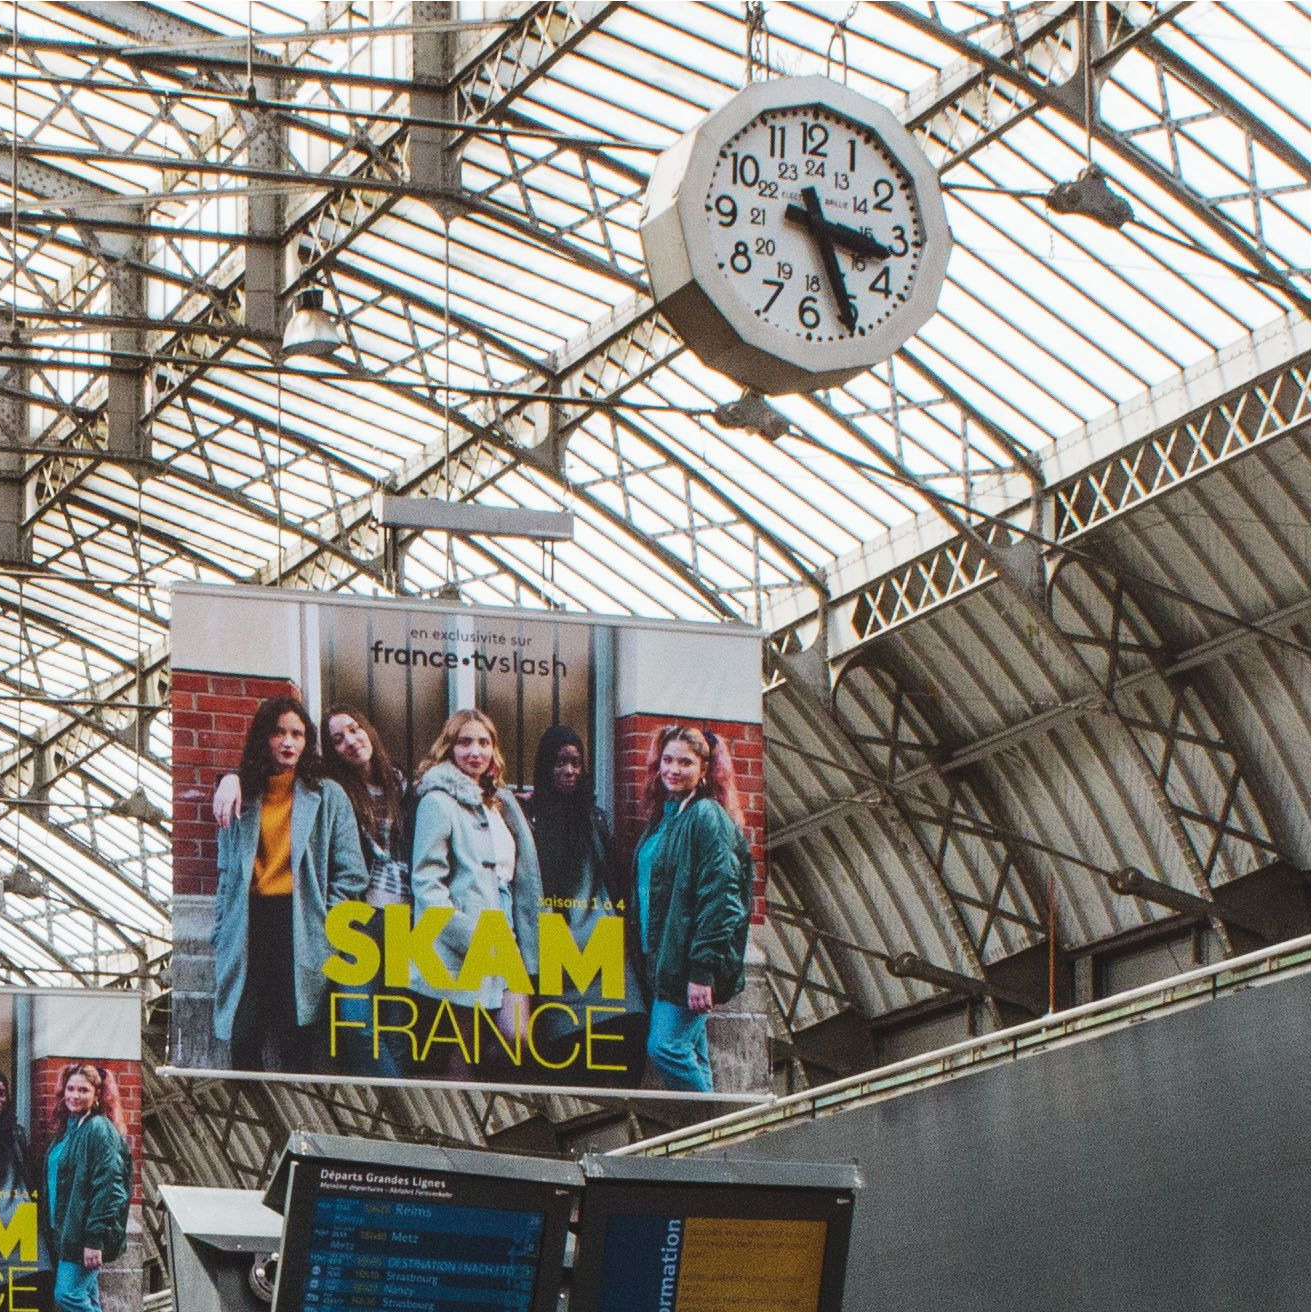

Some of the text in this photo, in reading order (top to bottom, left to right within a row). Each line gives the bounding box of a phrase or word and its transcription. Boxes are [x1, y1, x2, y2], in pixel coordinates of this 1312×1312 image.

[769, 124, 786, 158] 11
[801, 122, 828, 158] 12
[848, 139, 856, 172] 1
[730, 152, 759, 188] 10
[778, 162, 798, 180] 23
[805, 160, 826, 178] 24
[834, 172, 849, 190] 13
[758, 180, 778, 198] 22
[872, 179, 894, 212] 2
[715, 194, 737, 227] 9
[751, 208, 766, 226] 21
[853, 196, 867, 214] 14
[755, 238, 776, 256] 20
[891, 226, 908, 257] 3
[730, 241, 752, 274] 8
[776, 262, 792, 280] 19
[805, 275, 821, 292] 18
[868, 266, 892, 299] 4
[762, 279, 784, 313] 7
[798, 296, 821, 329] 6
[410, 629, 532, 648] en exclusivité sur
[591, 897, 599, 911] 1
[616, 898, 626, 912] 4
[322, 900, 626, 1001] SKAM
[329, 991, 629, 1072] FRANCE
[320, 1168, 446, 1190] Départs Grandes Lignes
[31, 1189, 39, 1200] 4
